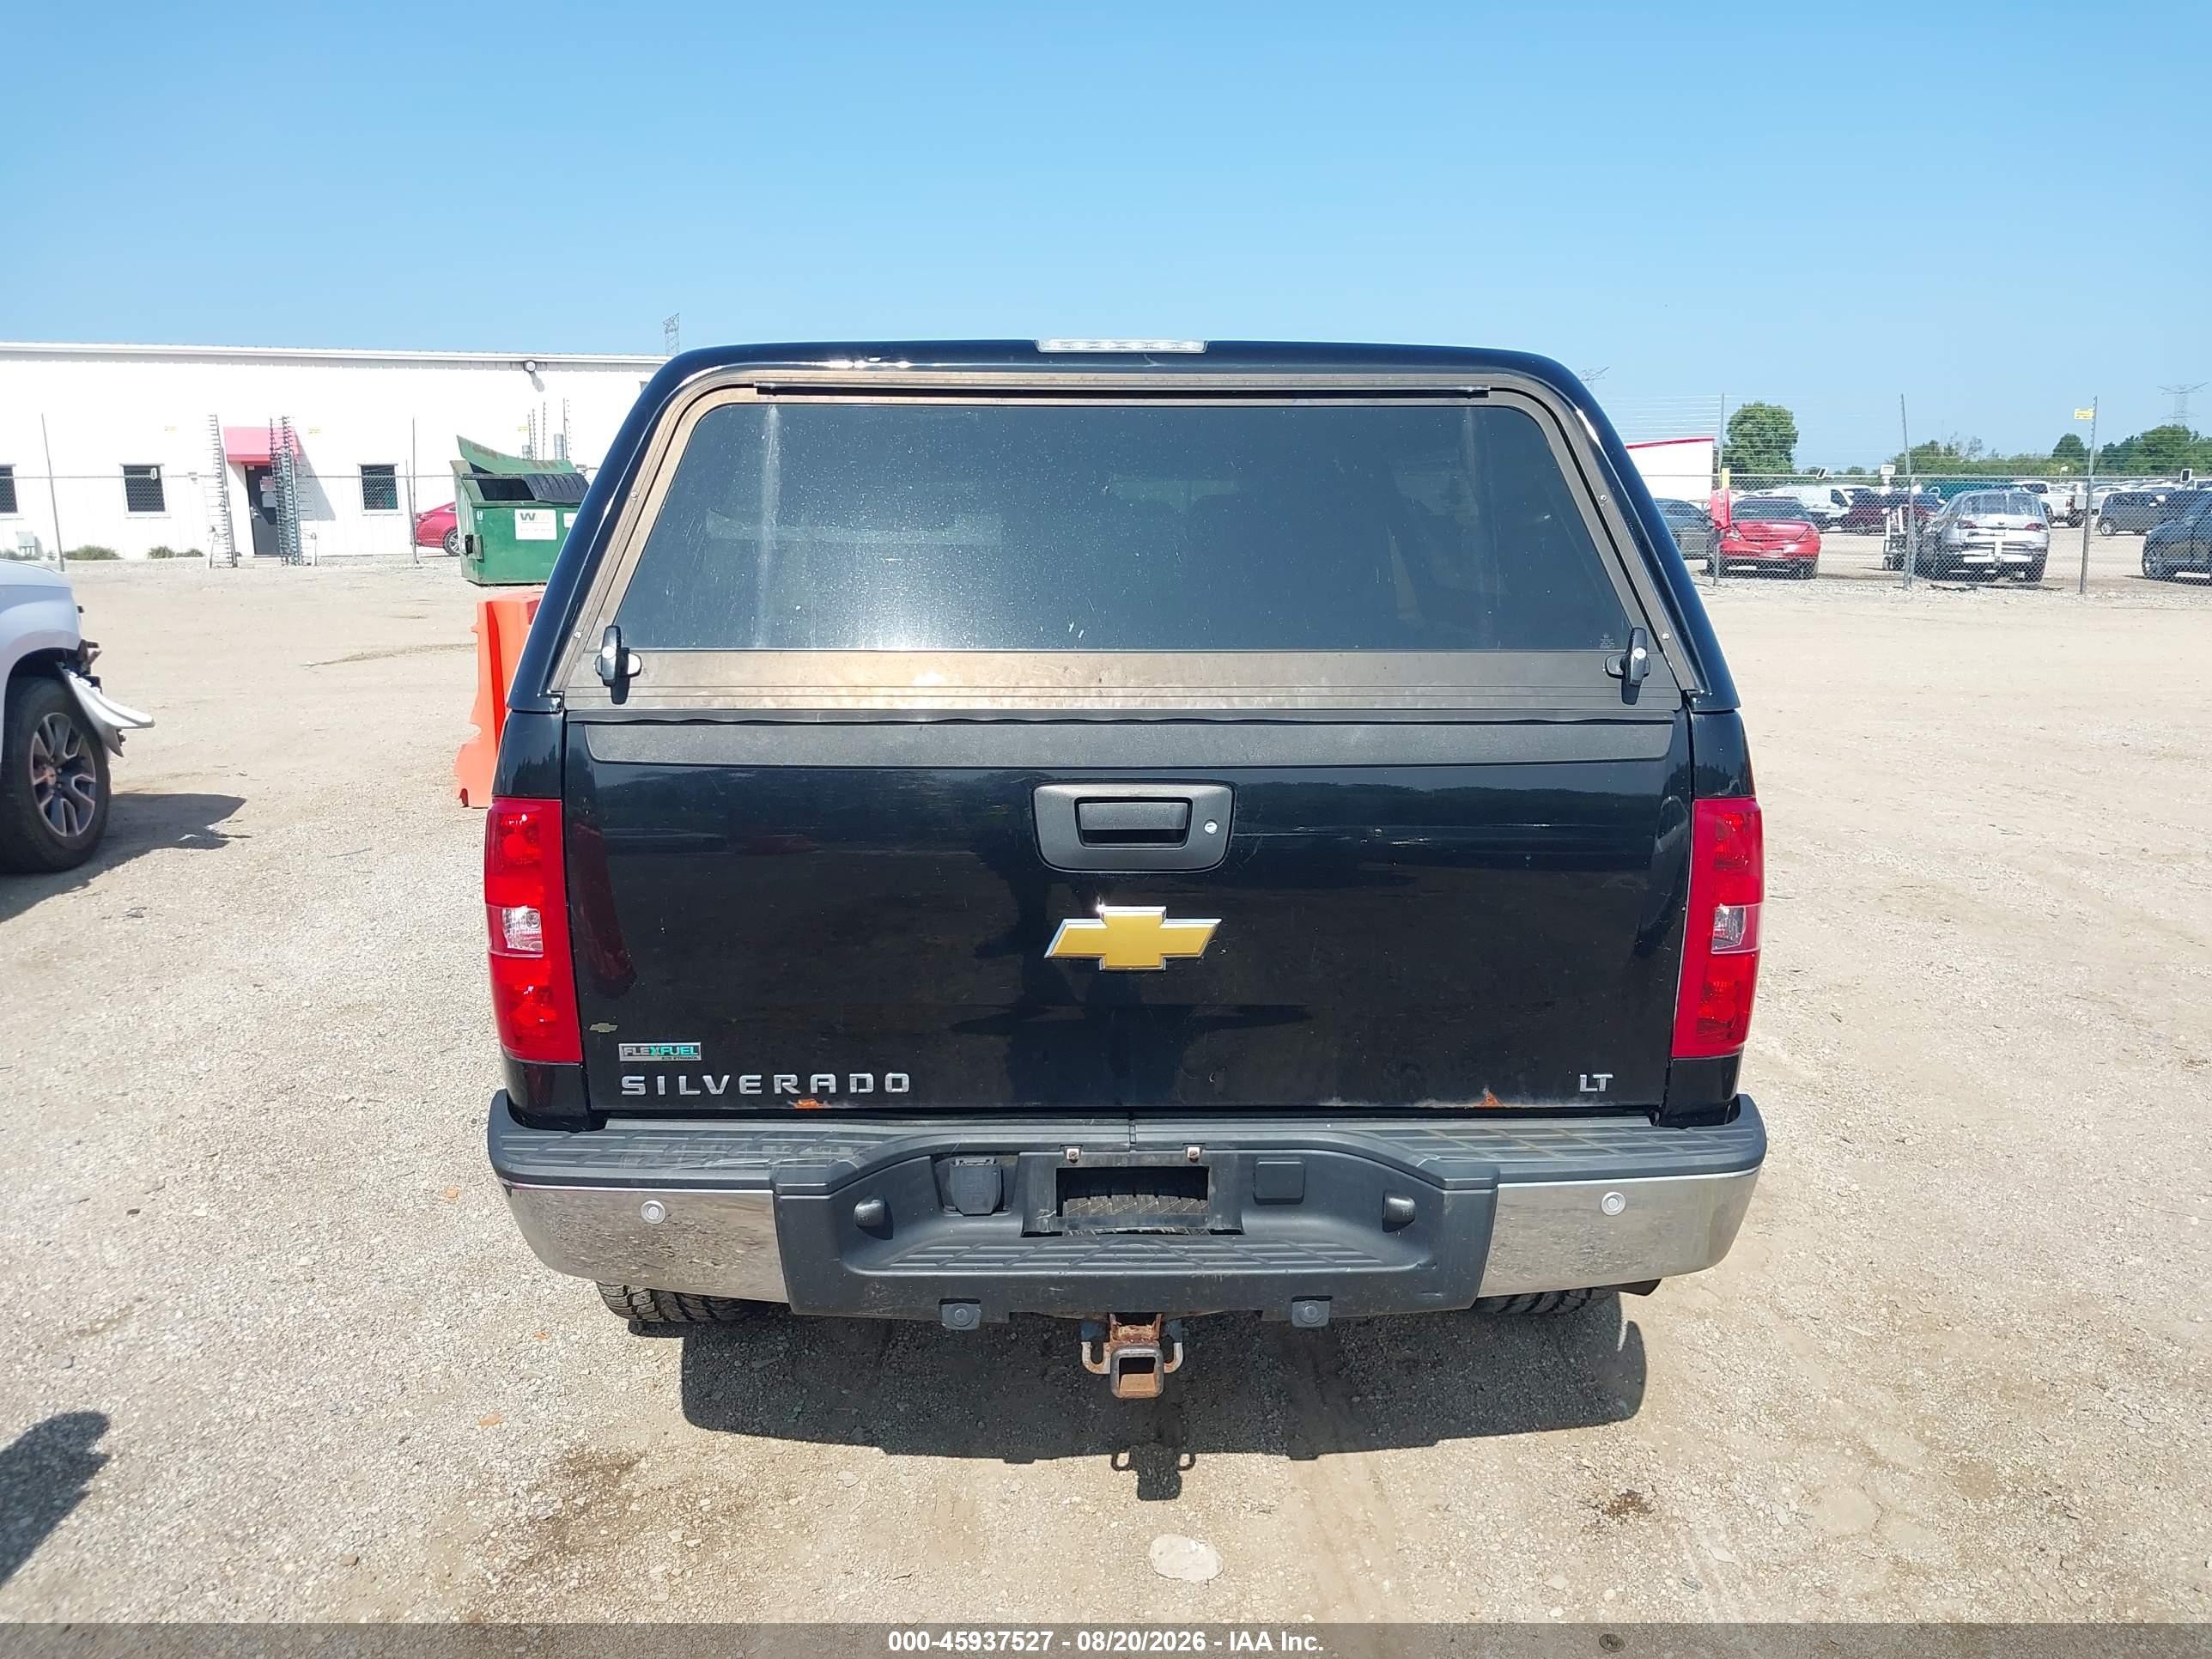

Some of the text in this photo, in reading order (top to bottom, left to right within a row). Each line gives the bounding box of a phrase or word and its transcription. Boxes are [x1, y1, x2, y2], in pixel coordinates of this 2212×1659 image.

[623, 1045, 699, 1056] FLEXFUEL
[621, 1073, 911, 1096] SILVERADO
[1579, 1073, 1613, 1092] LT
